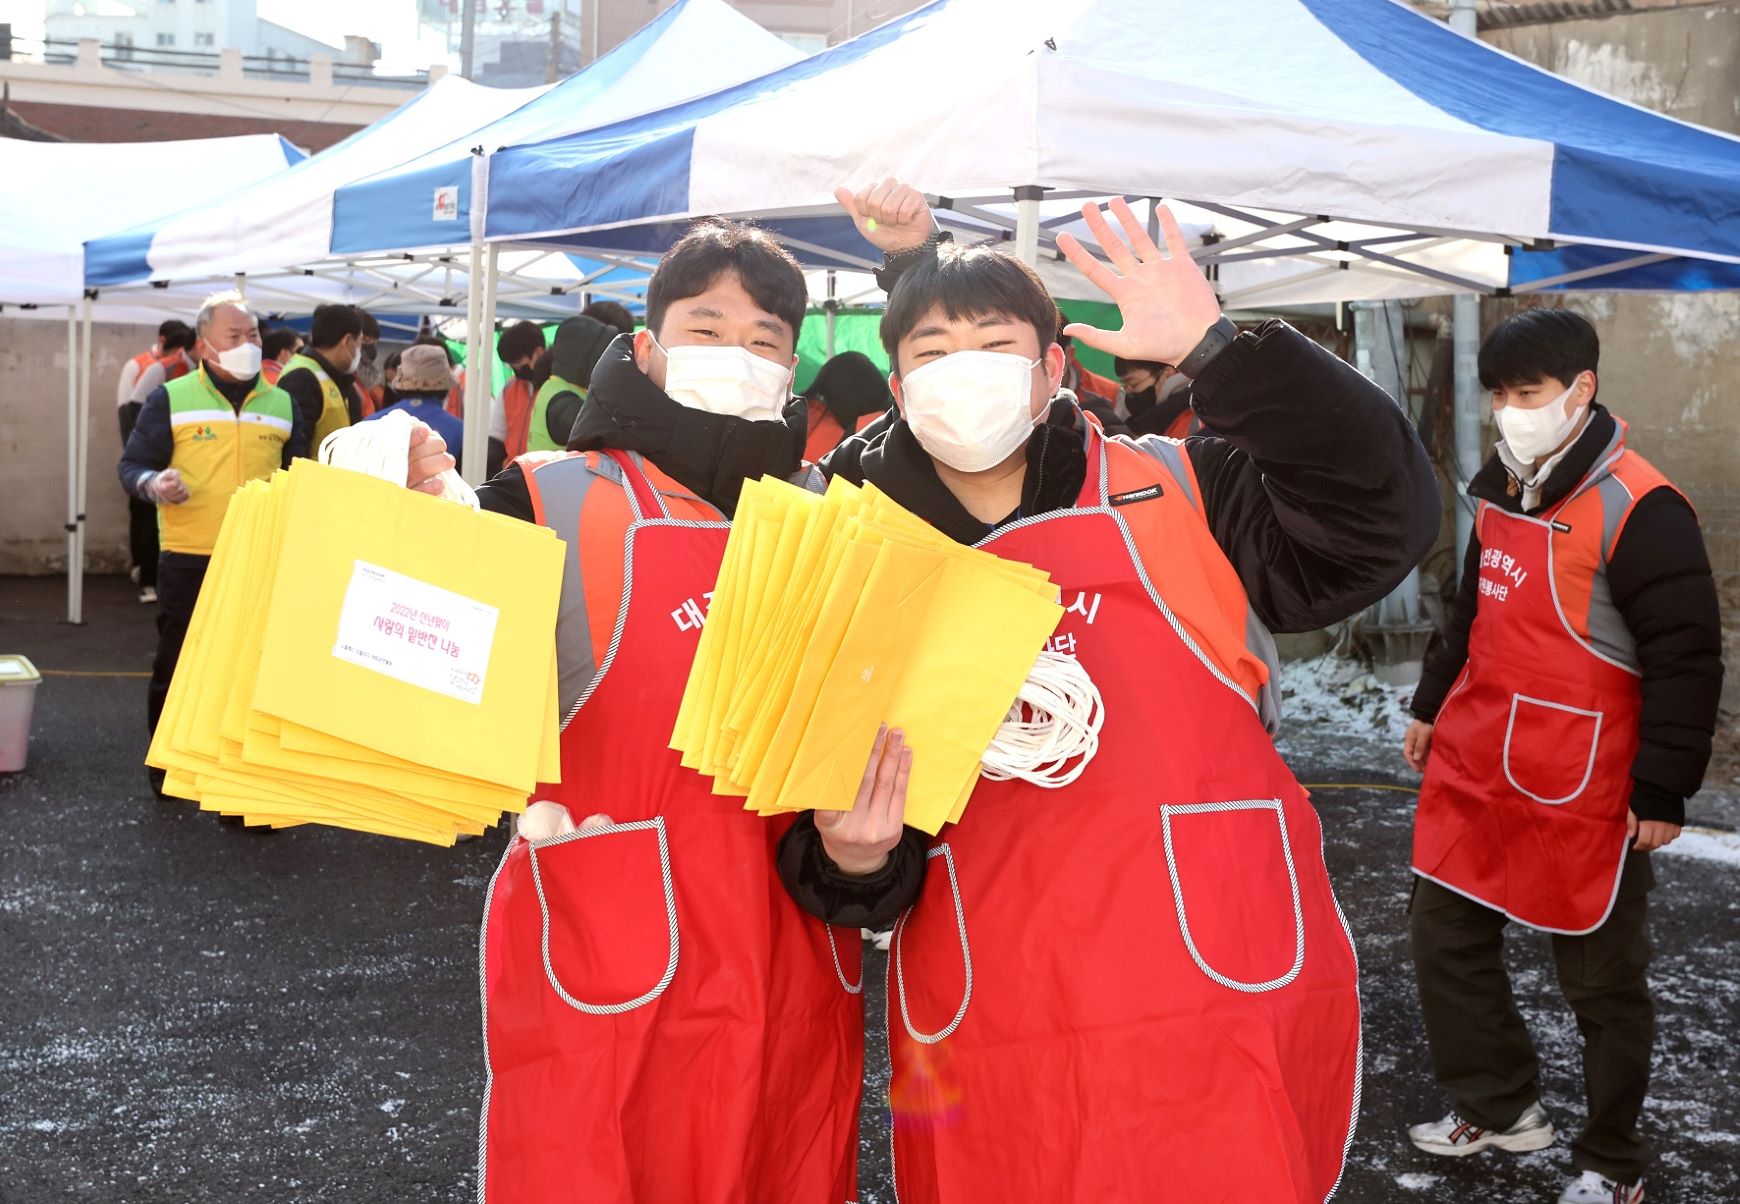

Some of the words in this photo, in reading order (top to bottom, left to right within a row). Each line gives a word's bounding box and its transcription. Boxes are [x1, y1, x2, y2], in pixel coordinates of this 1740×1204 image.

[1479, 547, 1528, 589] 전광역시
[390, 601, 418, 621] 2022년
[373, 615, 405, 639] 사랑의
